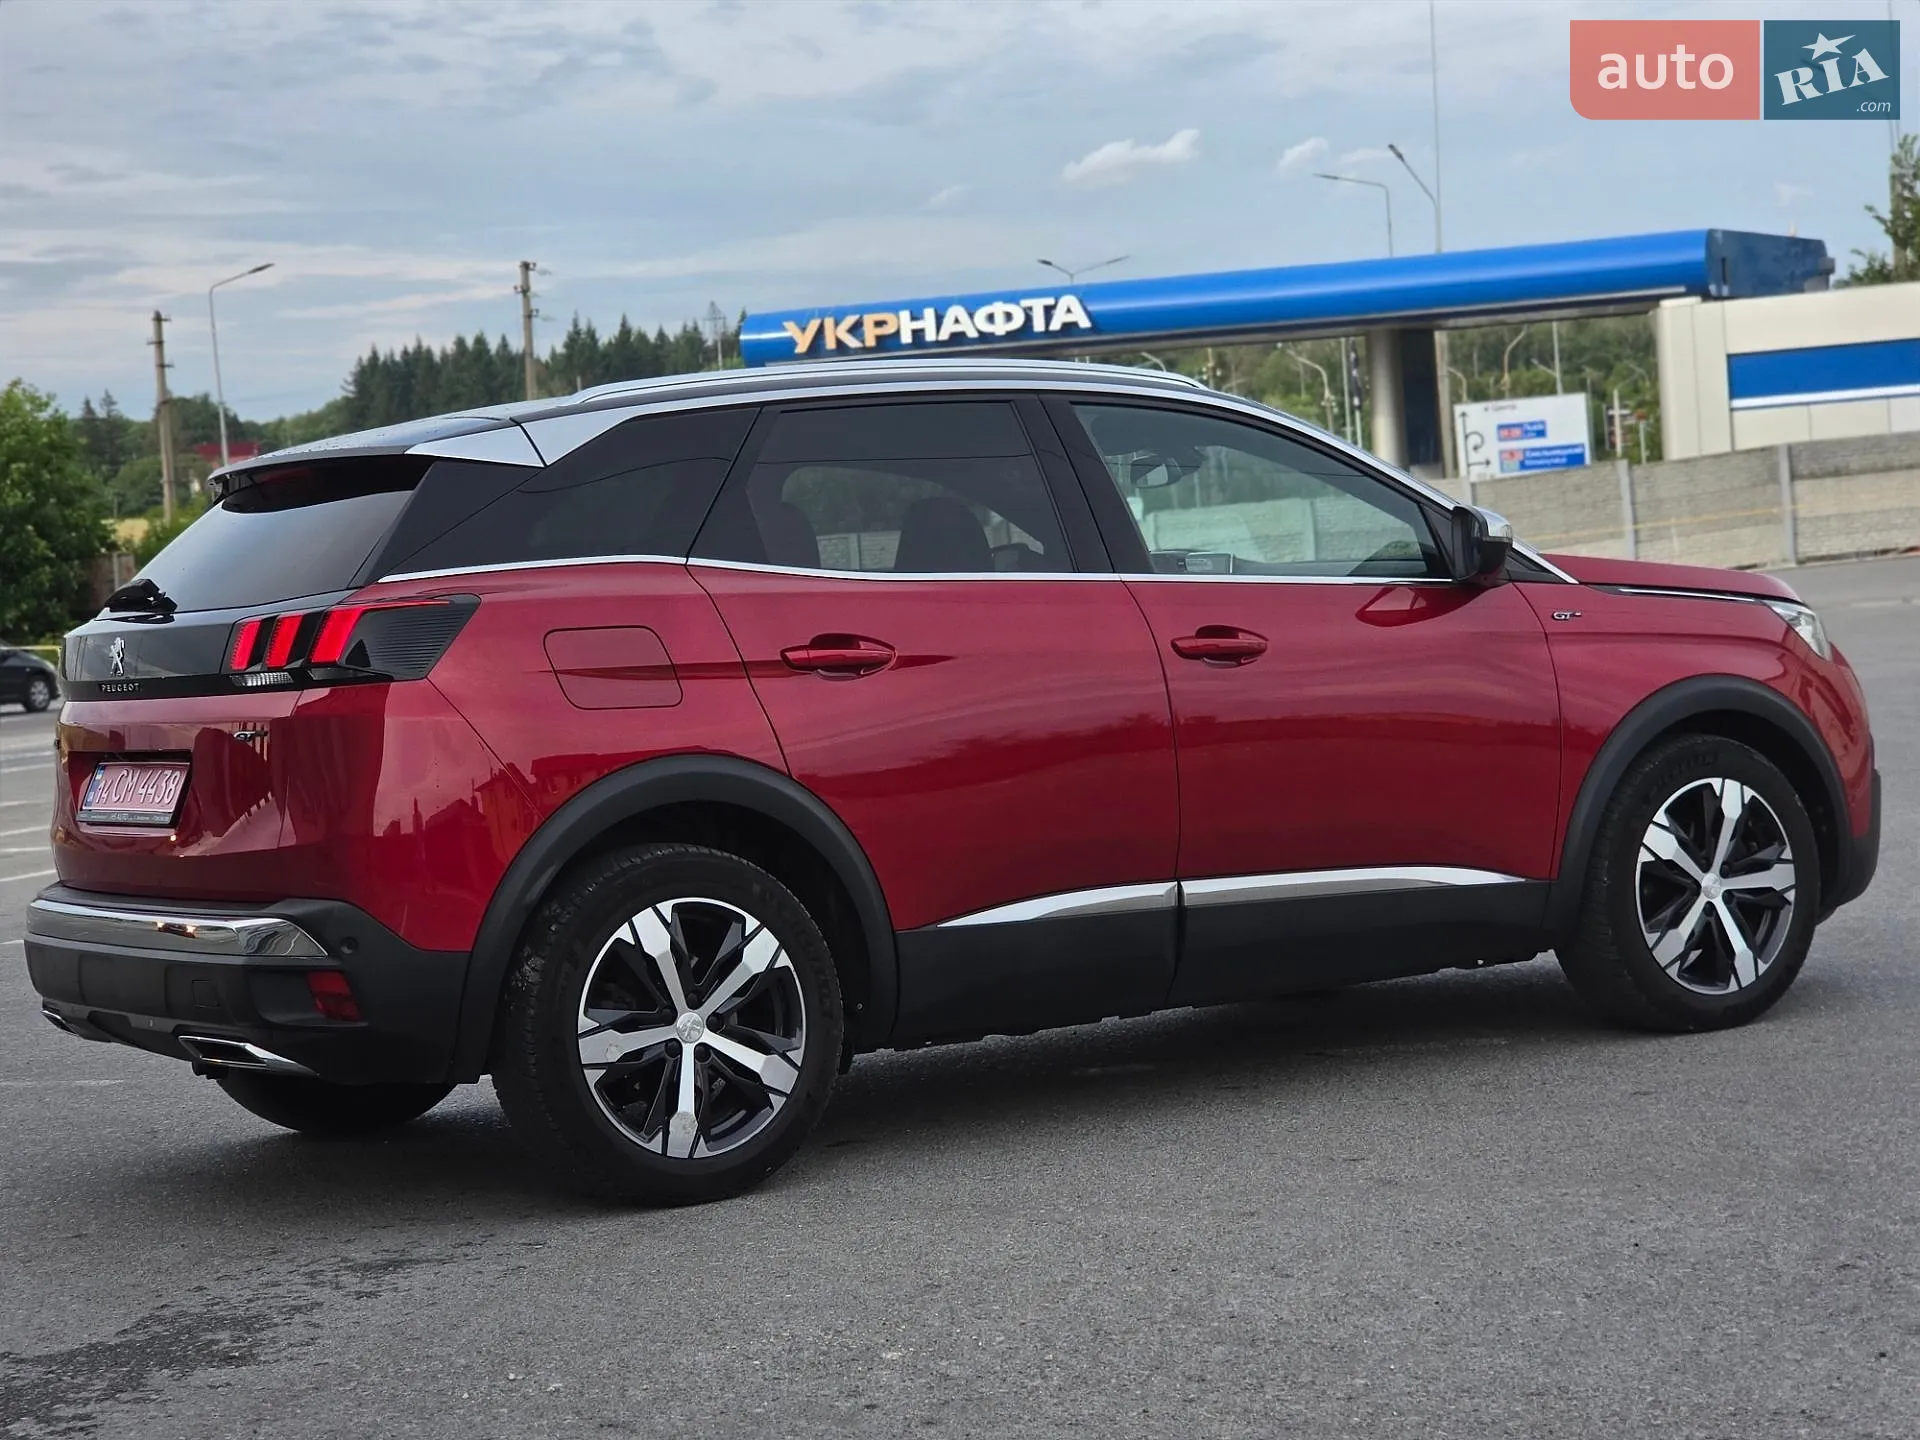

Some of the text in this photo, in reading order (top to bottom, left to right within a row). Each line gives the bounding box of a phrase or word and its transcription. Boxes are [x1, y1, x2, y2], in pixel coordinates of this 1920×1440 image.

[783, 294, 1092, 354] УКРНАФТА
[100, 683, 139, 692] PEUGEOT
[113, 768, 141, 803] CM
[138, 768, 181, 805] 4438
